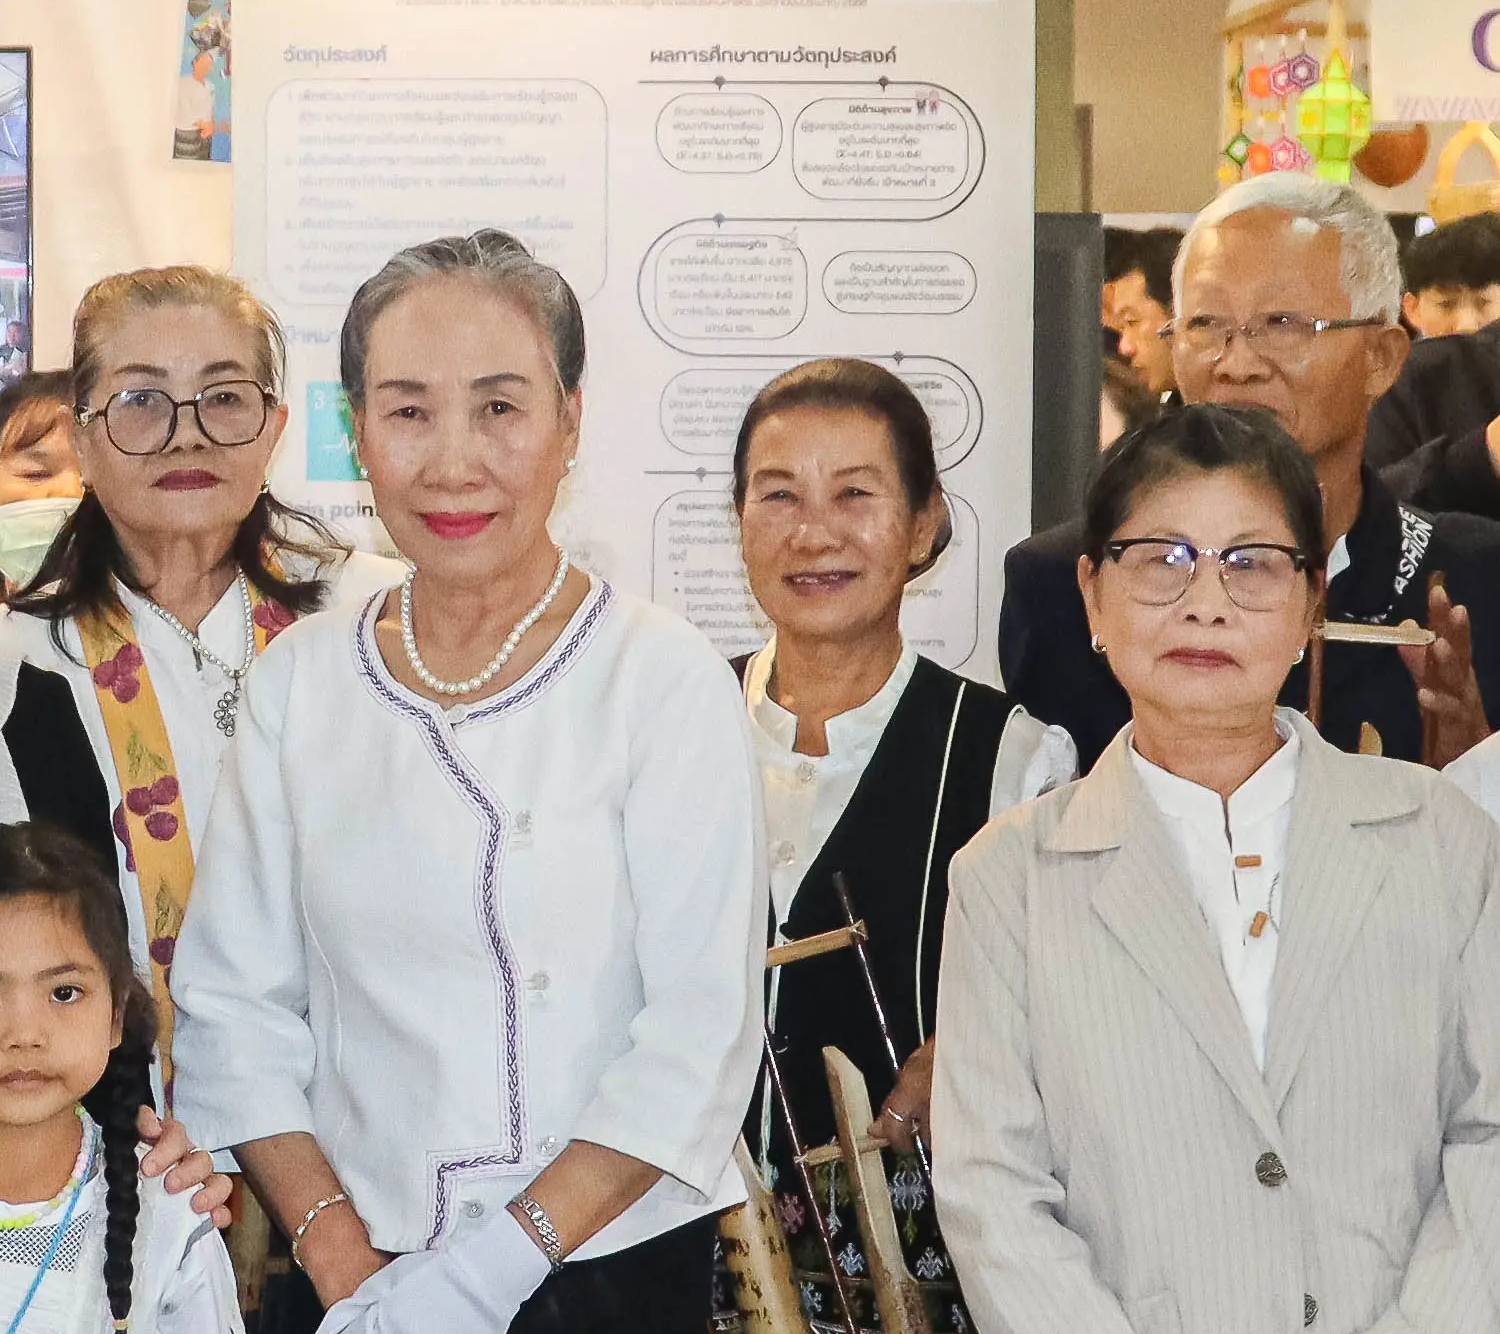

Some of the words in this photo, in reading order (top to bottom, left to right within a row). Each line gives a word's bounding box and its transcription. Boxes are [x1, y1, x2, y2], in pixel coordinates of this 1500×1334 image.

[650, 45, 897, 68] ผลการศึกษาตามวัตถุประสงค์
